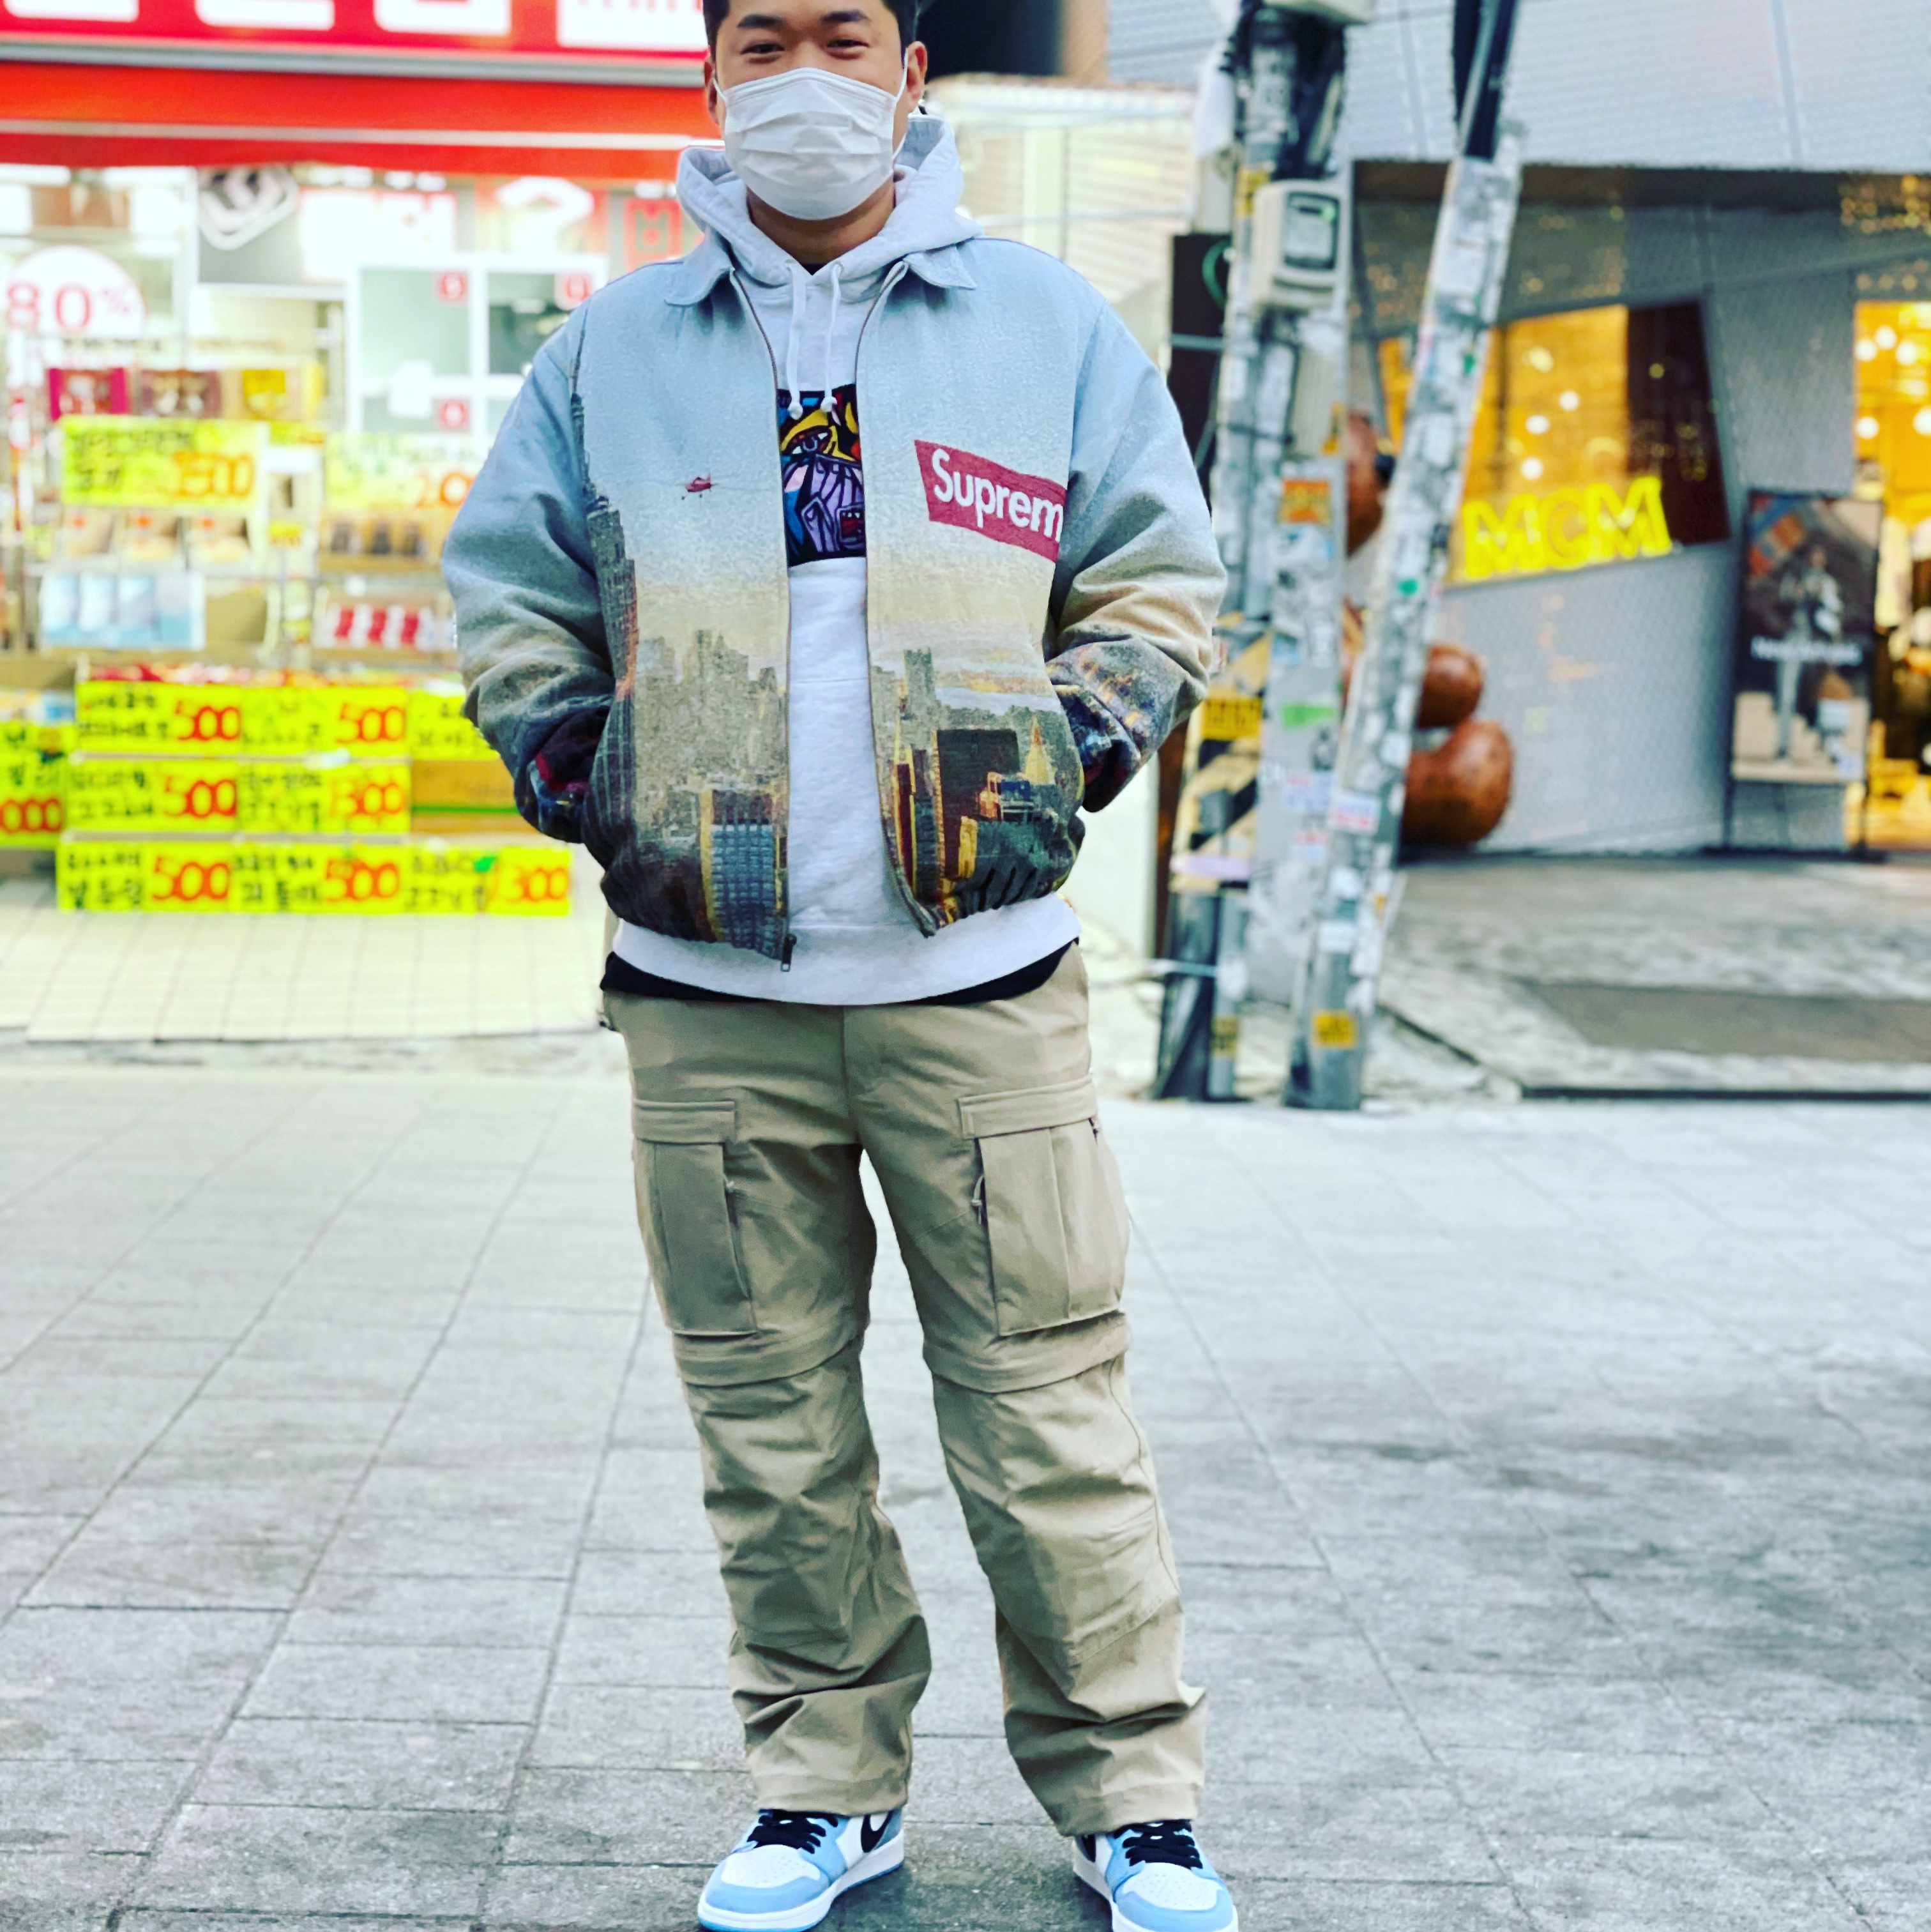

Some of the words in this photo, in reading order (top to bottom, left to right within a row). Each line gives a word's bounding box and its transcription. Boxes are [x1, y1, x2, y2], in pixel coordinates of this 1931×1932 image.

[931, 448, 1064, 543] Suprem
[174, 699, 241, 741] 500
[335, 701, 407, 743] 500
[163, 775, 238, 819] 500
[153, 855, 231, 902] 500
[324, 857, 402, 903] 500
